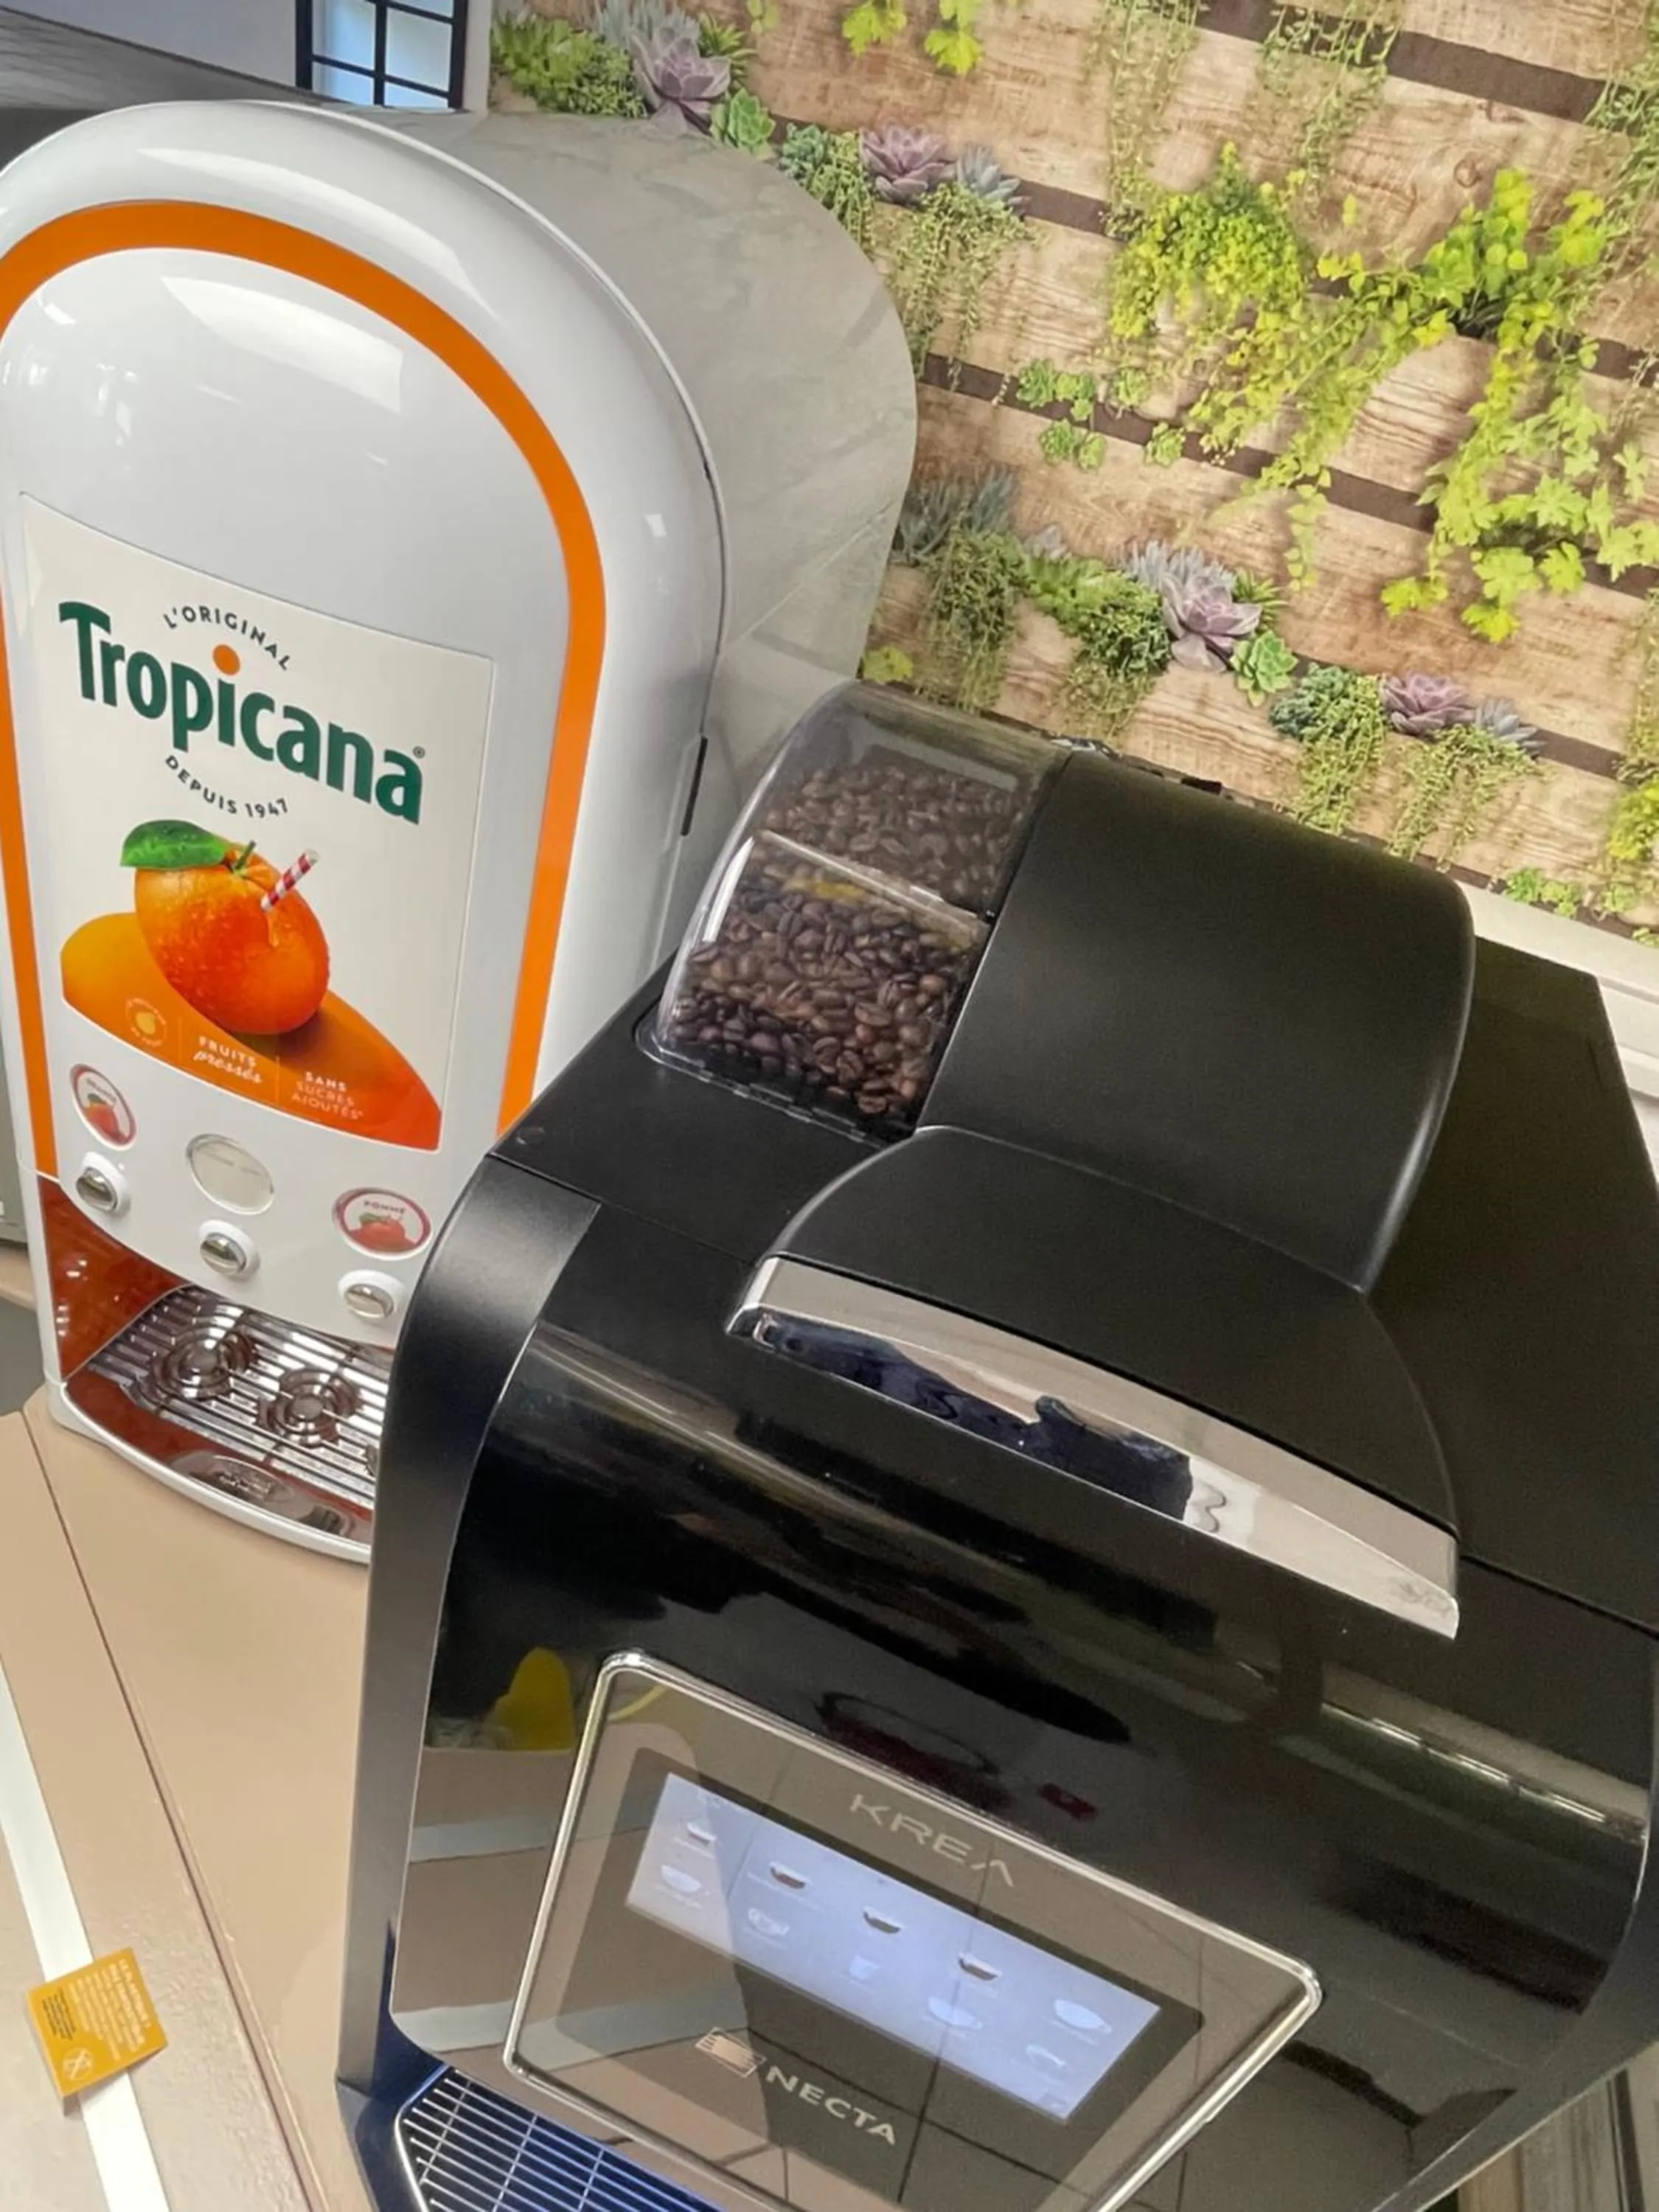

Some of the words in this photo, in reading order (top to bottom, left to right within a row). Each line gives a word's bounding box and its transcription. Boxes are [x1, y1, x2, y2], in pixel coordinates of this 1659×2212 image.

[163, 605, 290, 670] L'ORIGINAL
[165, 755, 237, 814] DEPUIS
[245, 798, 288, 818] 1947
[198, 1035, 257, 1068] FRUITS
[305, 1071, 347, 1092] SANS
[296, 1081, 355, 1106] SUCRES
[849, 1793, 1015, 1888] KREA
[765, 2065, 896, 2146] NECTA
